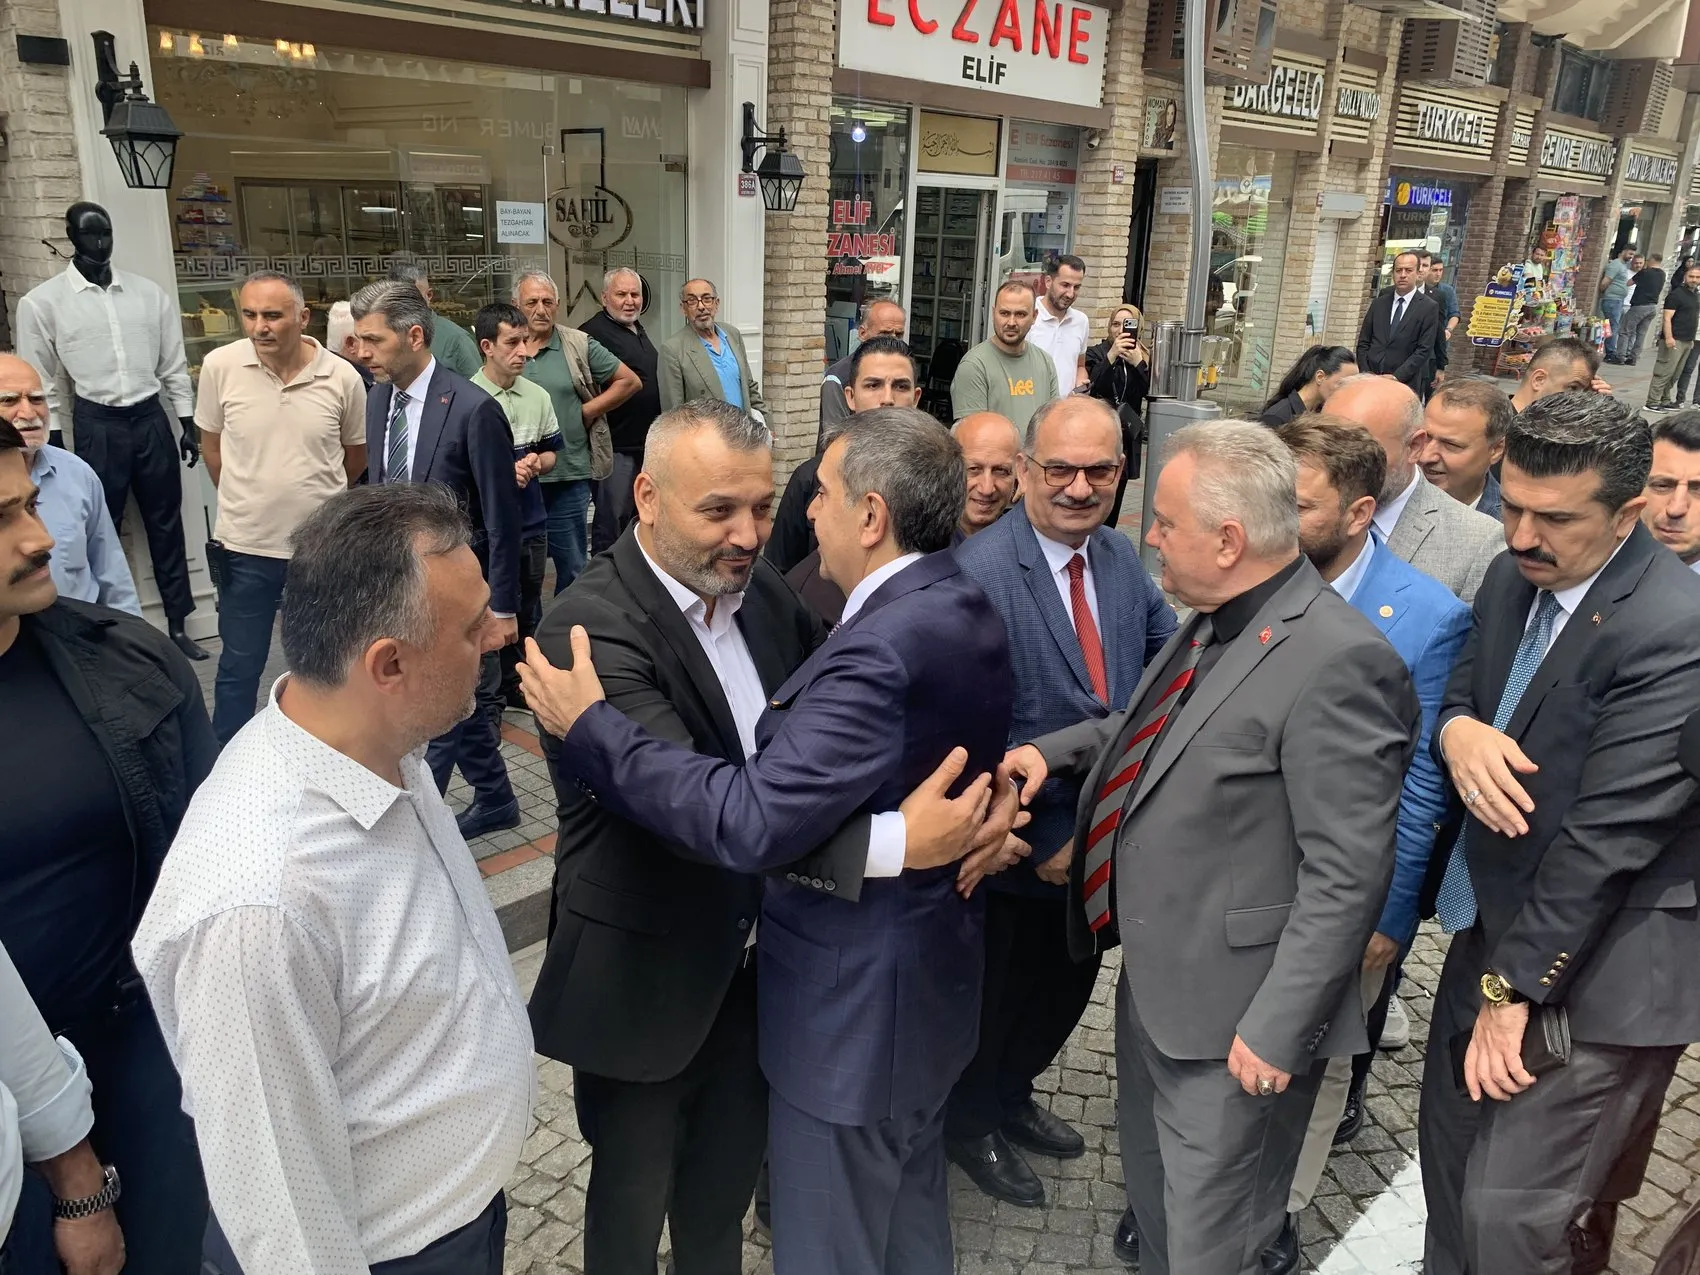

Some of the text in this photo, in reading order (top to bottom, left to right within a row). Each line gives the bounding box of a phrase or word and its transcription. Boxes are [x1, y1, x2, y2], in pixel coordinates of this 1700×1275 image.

[962, 55, 1007, 85] ELİF
[1233, 65, 1325, 119] BARGELLO
[1338, 88, 1380, 119] BOLLYWOOD
[1416, 103, 1486, 145] TURKCELL
[1540, 134, 1577, 168] CEMRE
[833, 194, 872, 225] ELİF
[1411, 185, 1453, 207] TURKCELL
[827, 227, 896, 257] ZANESİ
[833, 262, 863, 275] Ahmet
[1007, 376, 1034, 396] Lee
